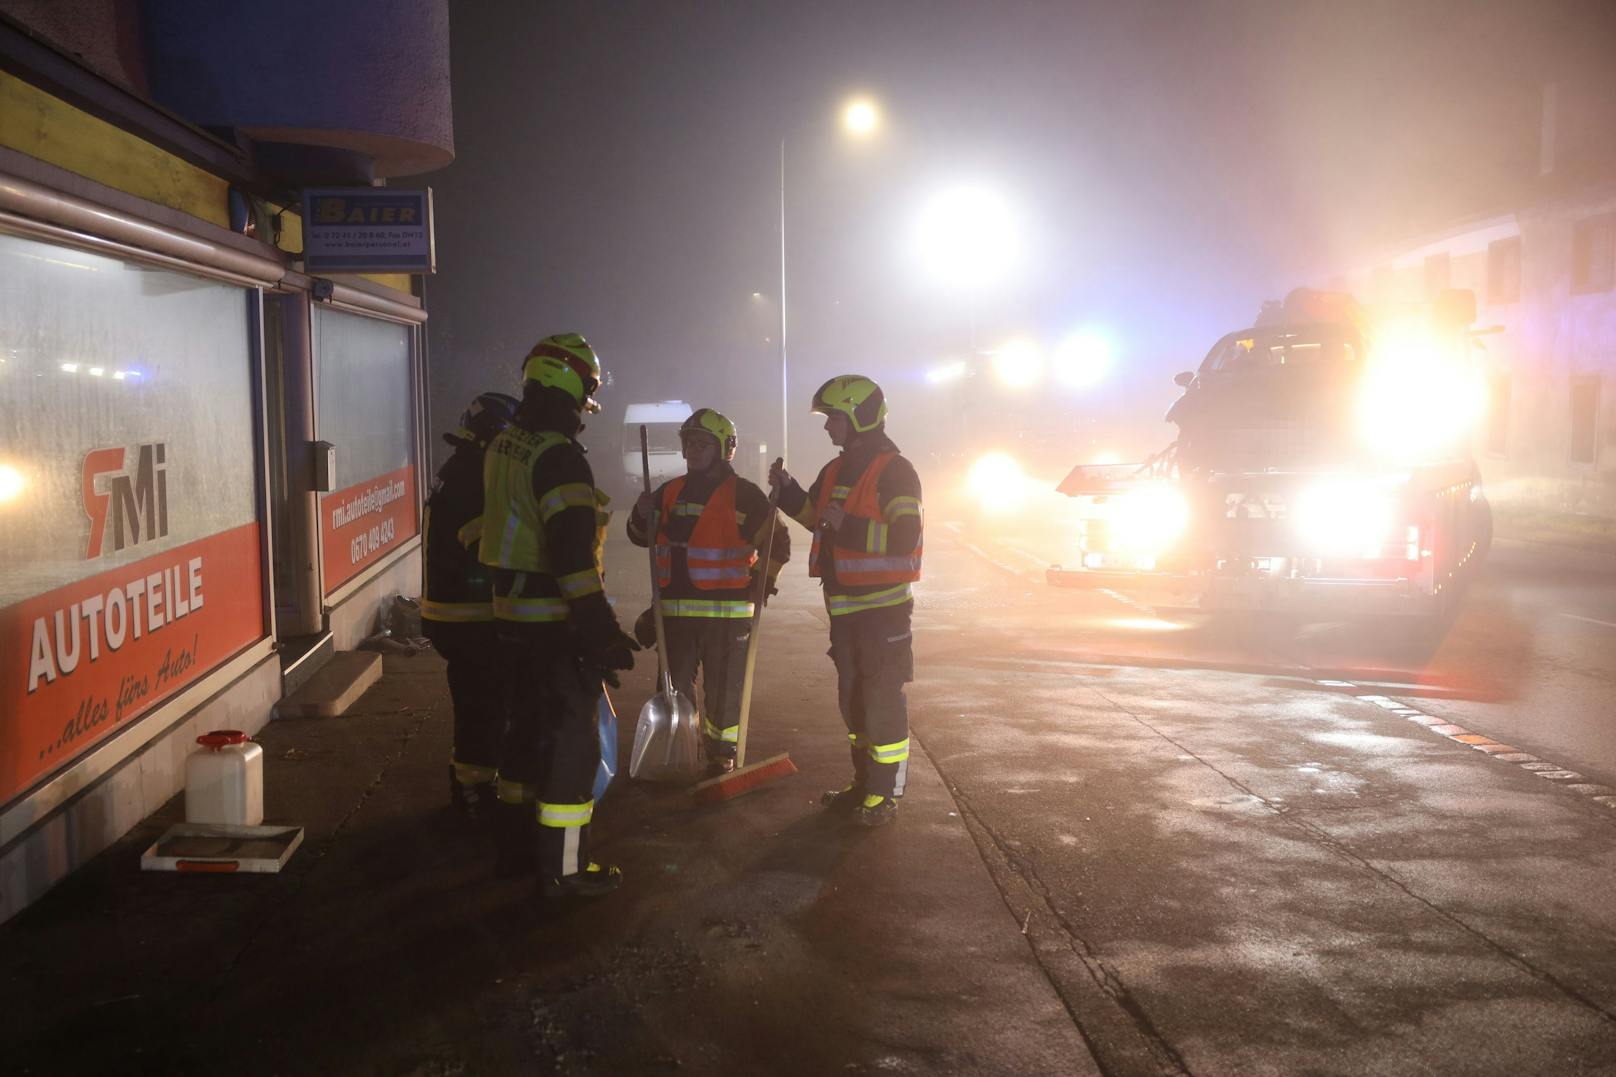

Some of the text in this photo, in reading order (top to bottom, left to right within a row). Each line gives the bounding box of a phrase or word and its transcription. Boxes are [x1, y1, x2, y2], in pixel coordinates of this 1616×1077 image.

[319, 198, 417, 224] BAIER
[332, 480, 405, 530] rmi.autoteile@gmail.com
[27, 556, 204, 695] AUTOTEILE
[115, 673, 150, 719] fürs
[154, 634, 199, 690] Auto!
